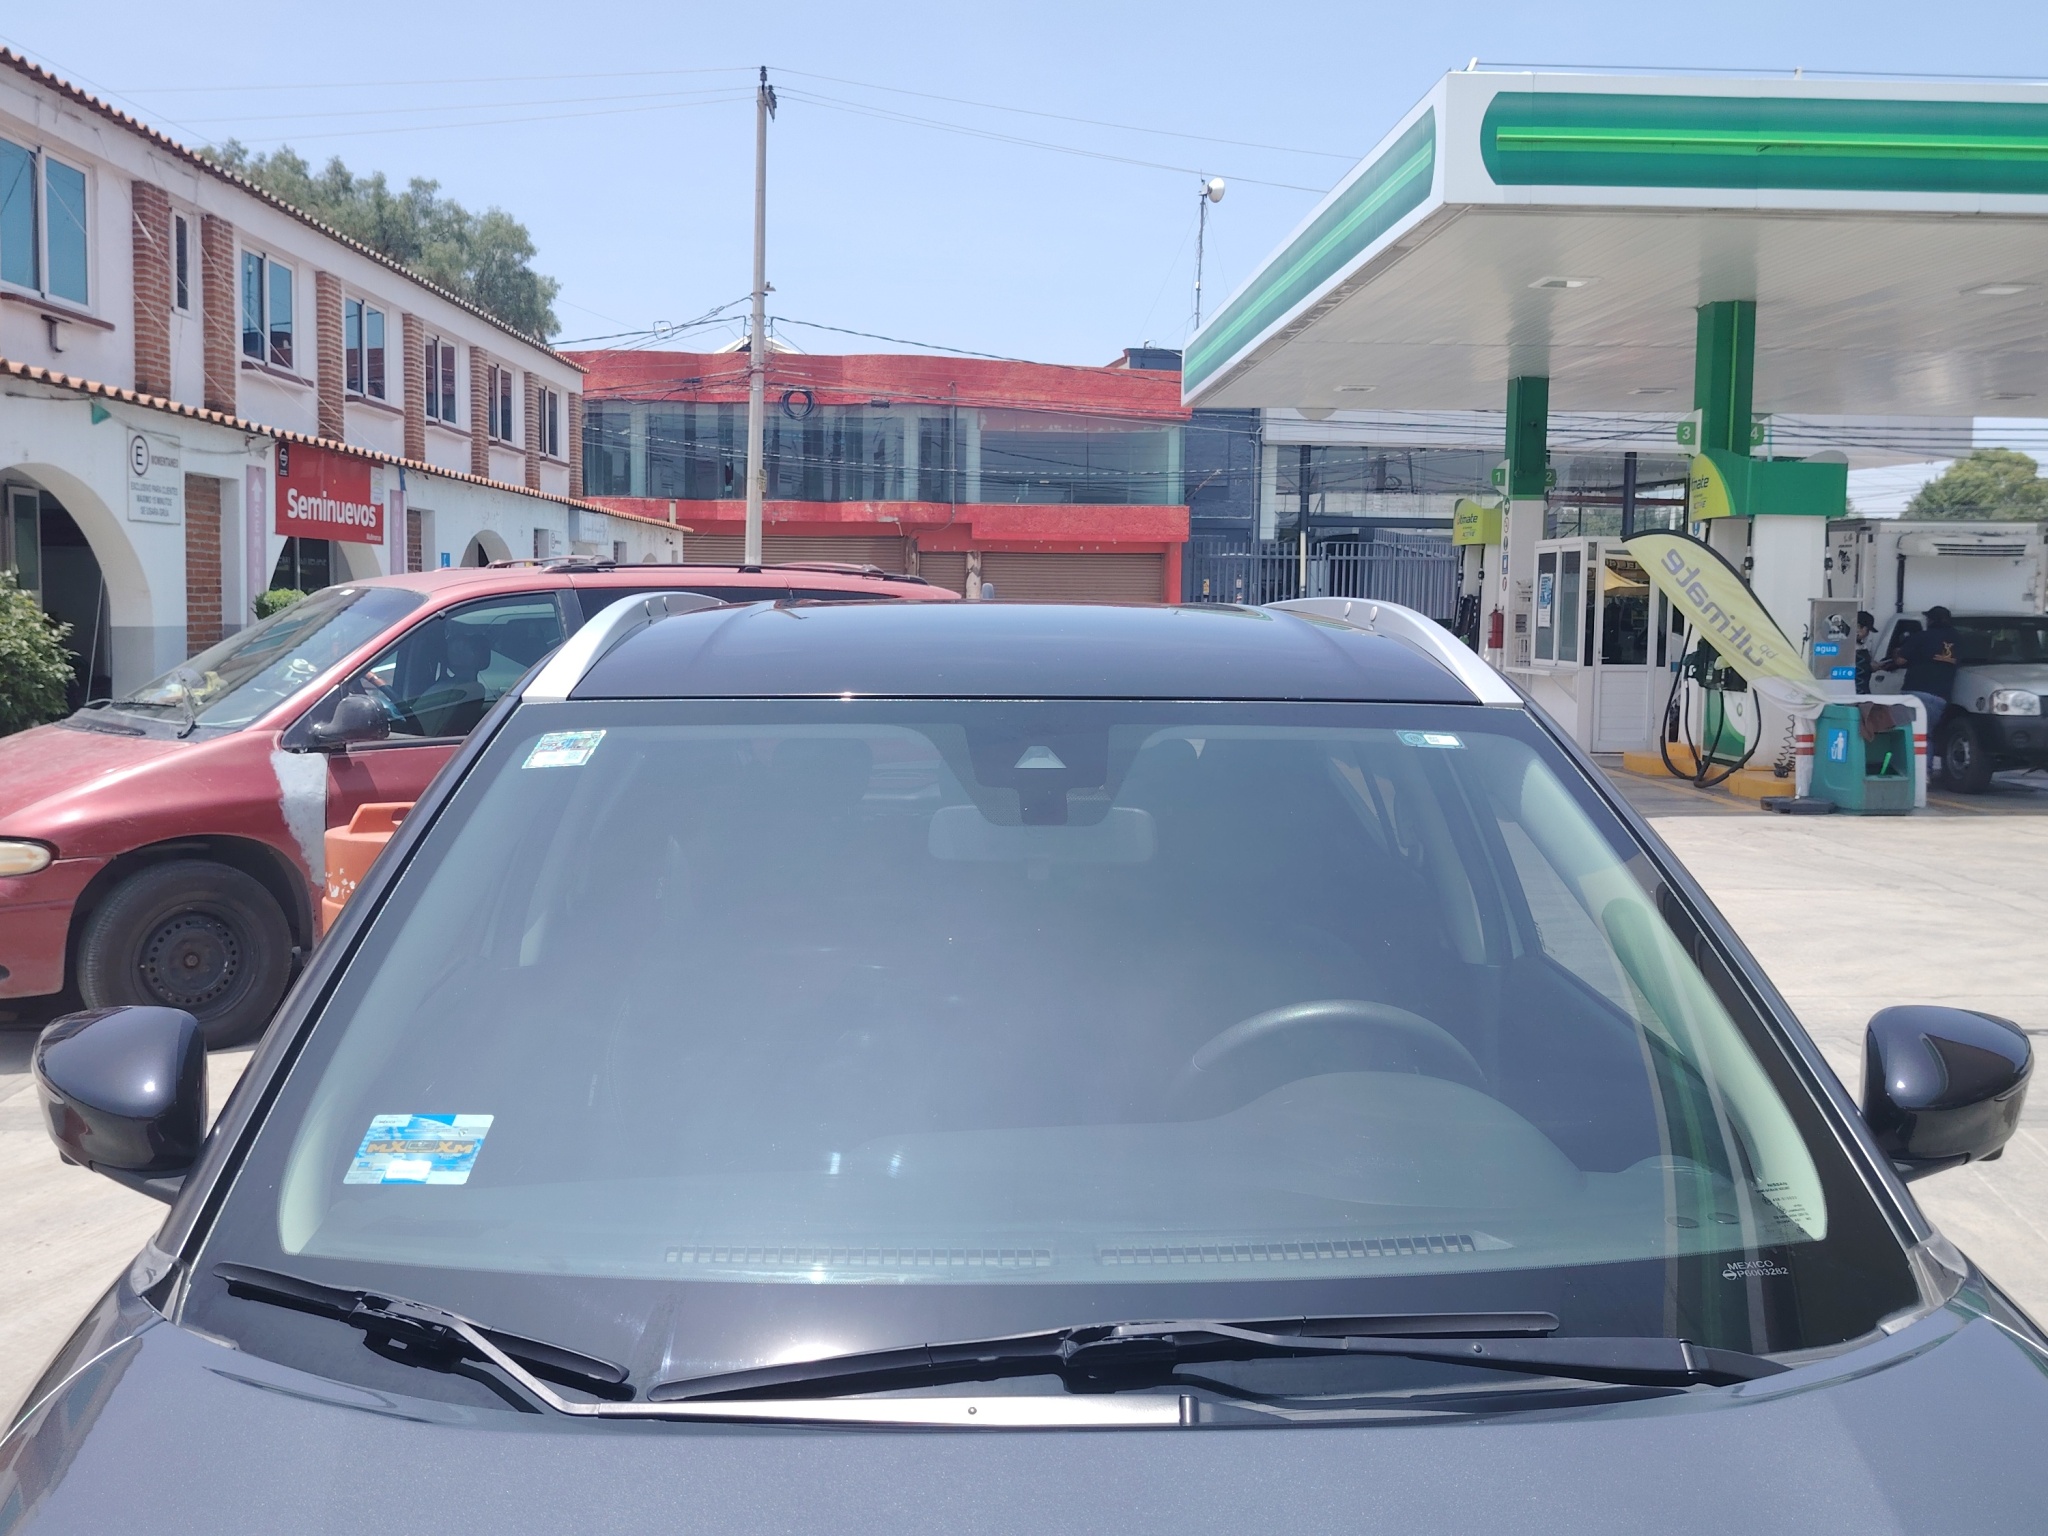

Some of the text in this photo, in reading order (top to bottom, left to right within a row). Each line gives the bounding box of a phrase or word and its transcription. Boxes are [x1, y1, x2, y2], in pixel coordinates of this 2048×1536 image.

[1682, 426, 1691, 440] 3
[1750, 426, 1759, 440] 4
[136, 445, 144, 466] E
[1495, 471, 1501, 482] 1
[1545, 472, 1552, 482] 2
[287, 487, 377, 528] Seminuevos
[1815, 645, 1837, 654] agua
[1832, 668, 1853, 677] aire
[1726, 1260, 1774, 1271] MEXICO
